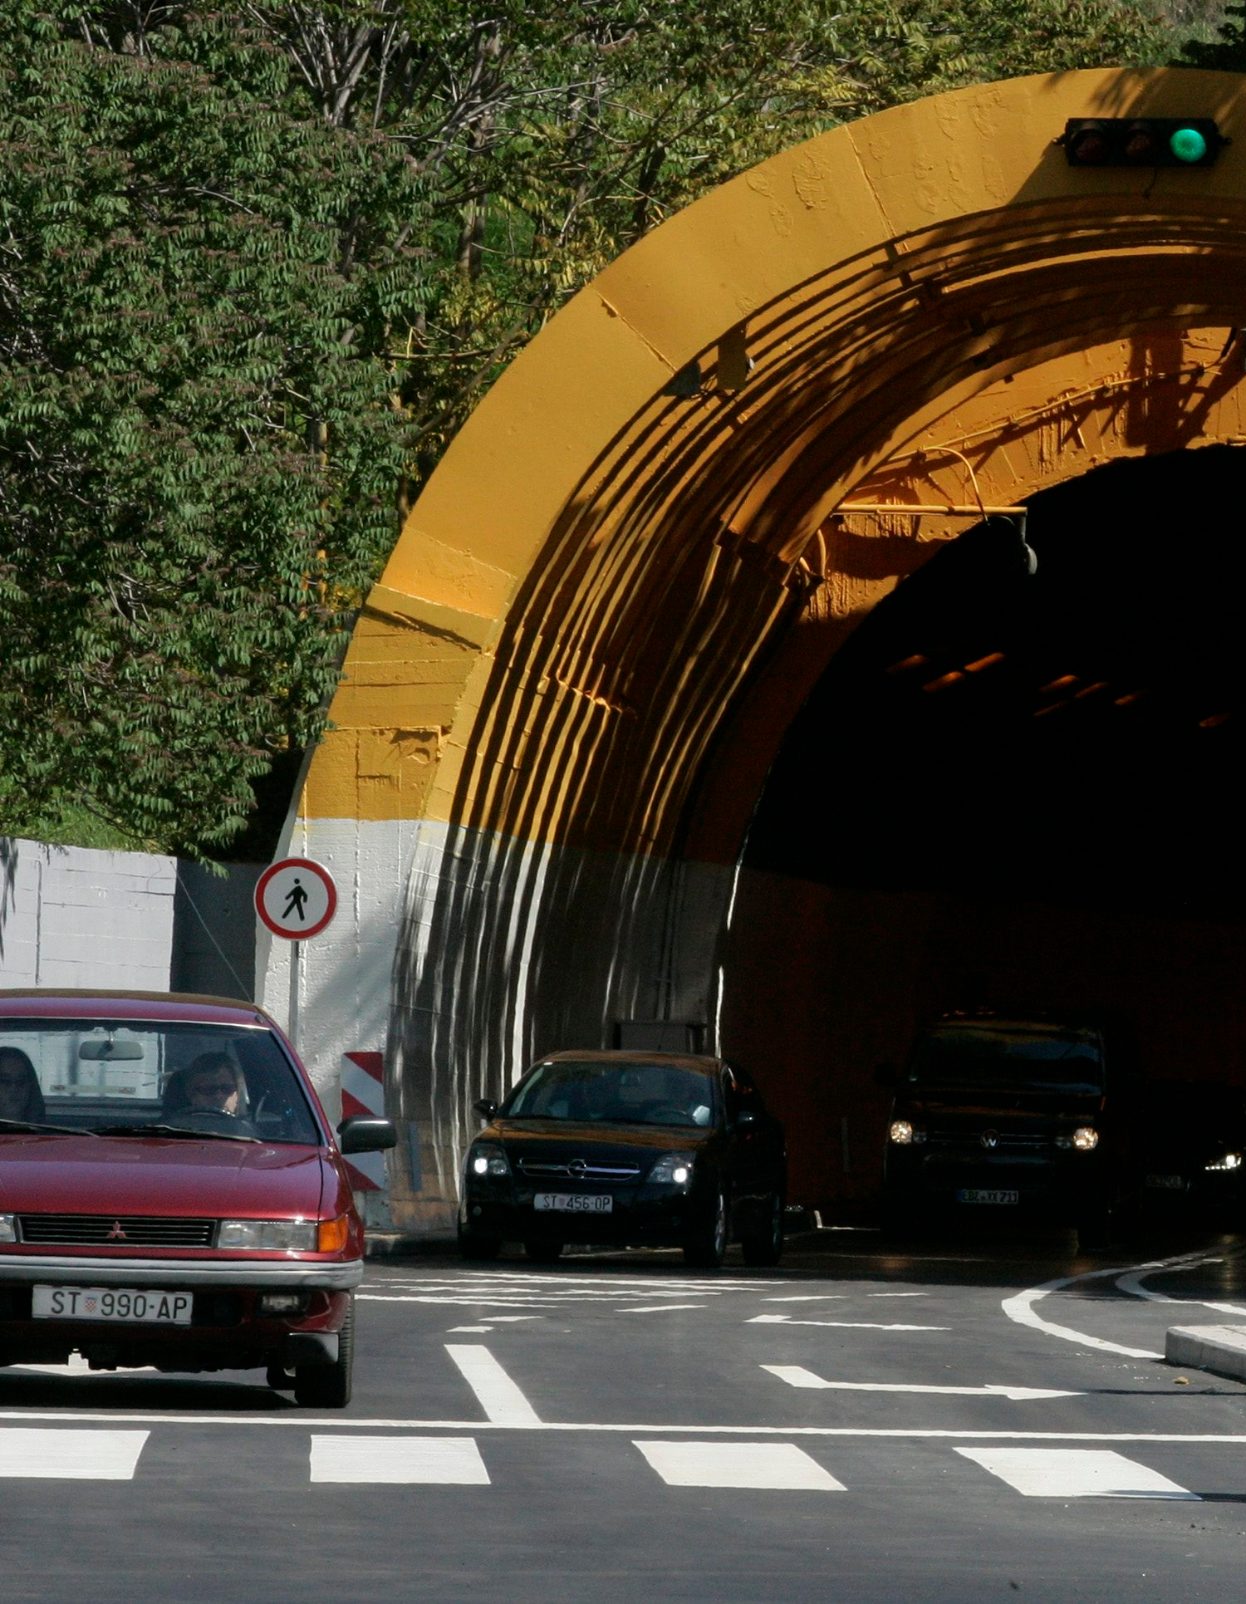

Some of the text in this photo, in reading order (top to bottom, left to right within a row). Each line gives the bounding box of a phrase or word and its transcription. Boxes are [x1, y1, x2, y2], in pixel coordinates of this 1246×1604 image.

[543, 1195, 558, 1209] ST
[50, 1291, 188, 1320] ST 990-AP
